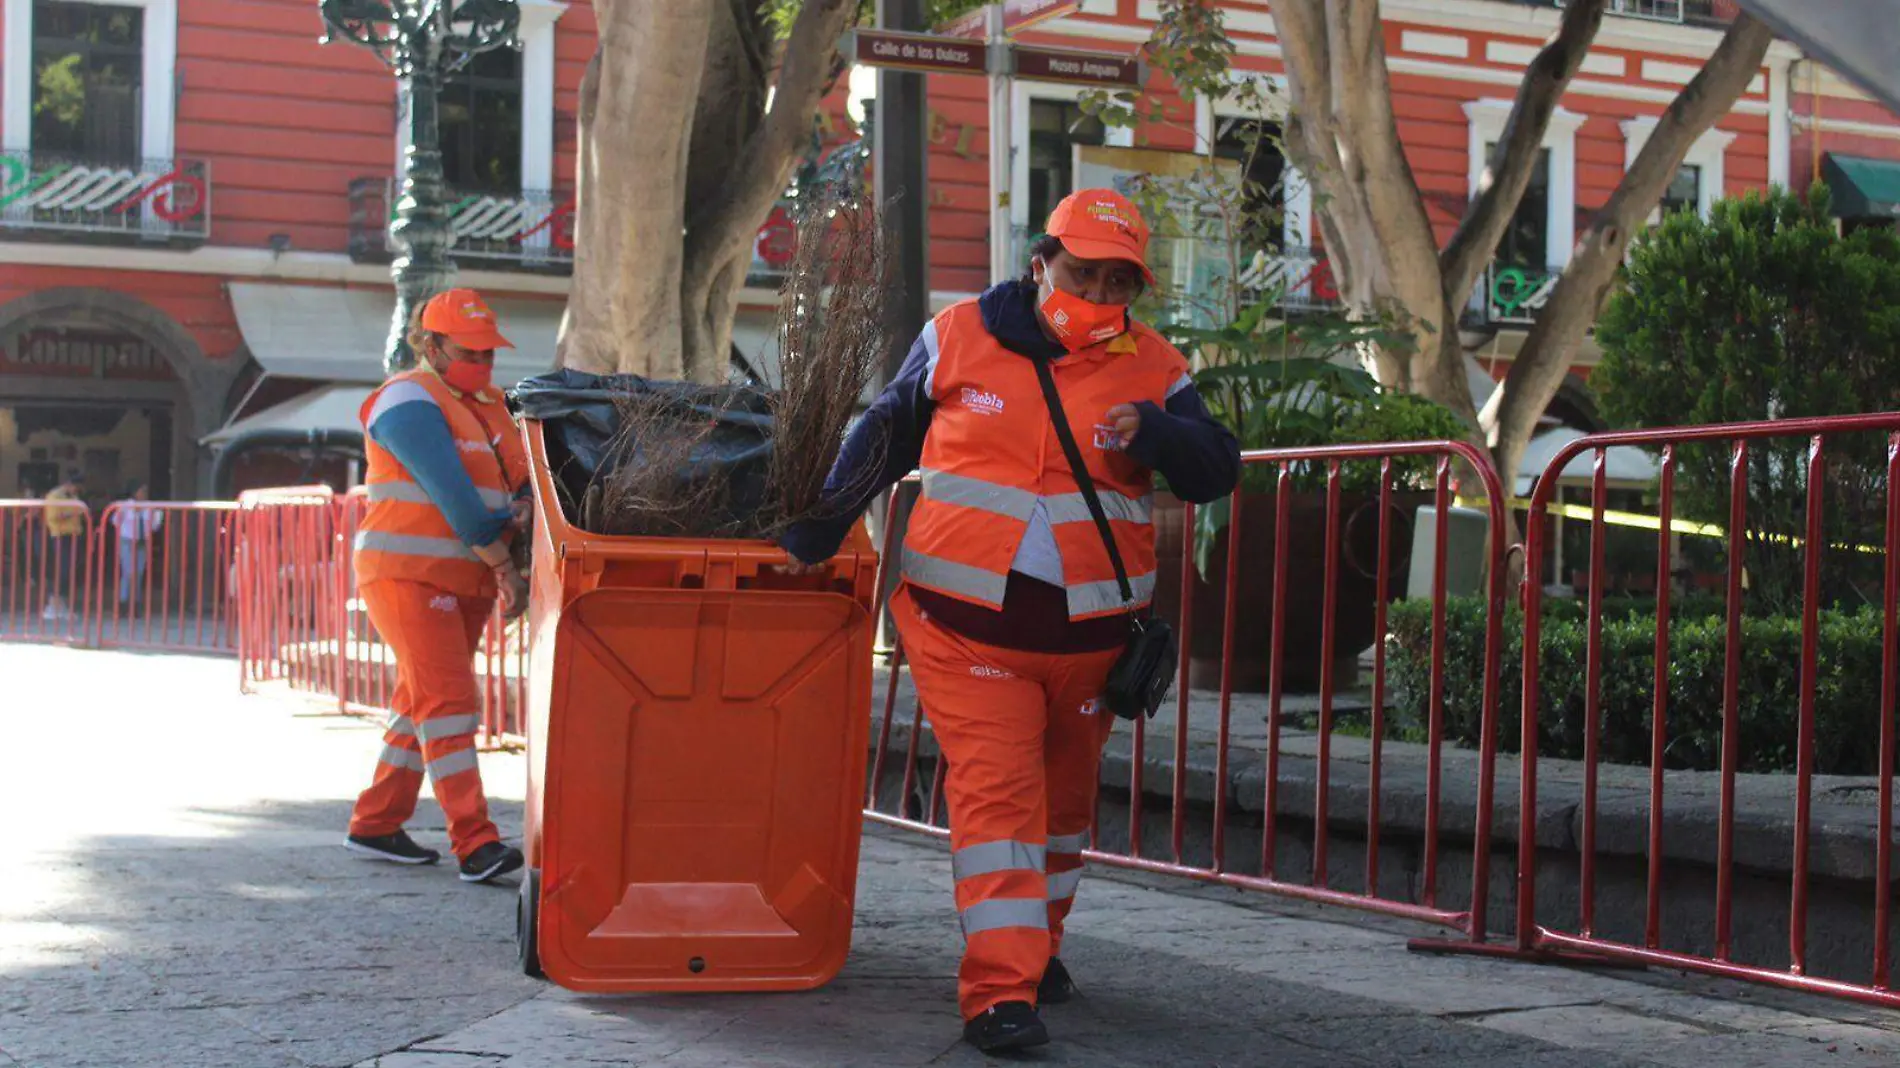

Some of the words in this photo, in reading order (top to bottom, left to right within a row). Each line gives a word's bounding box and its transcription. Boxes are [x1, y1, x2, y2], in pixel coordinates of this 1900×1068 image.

[873, 40, 899, 56] Calle
[902, 44, 916, 58] de
[917, 44, 934, 60] los
[936, 46, 970, 64] Dulces
[1048, 58, 1080, 74] Museo
[1082, 60, 1120, 79] Amparo
